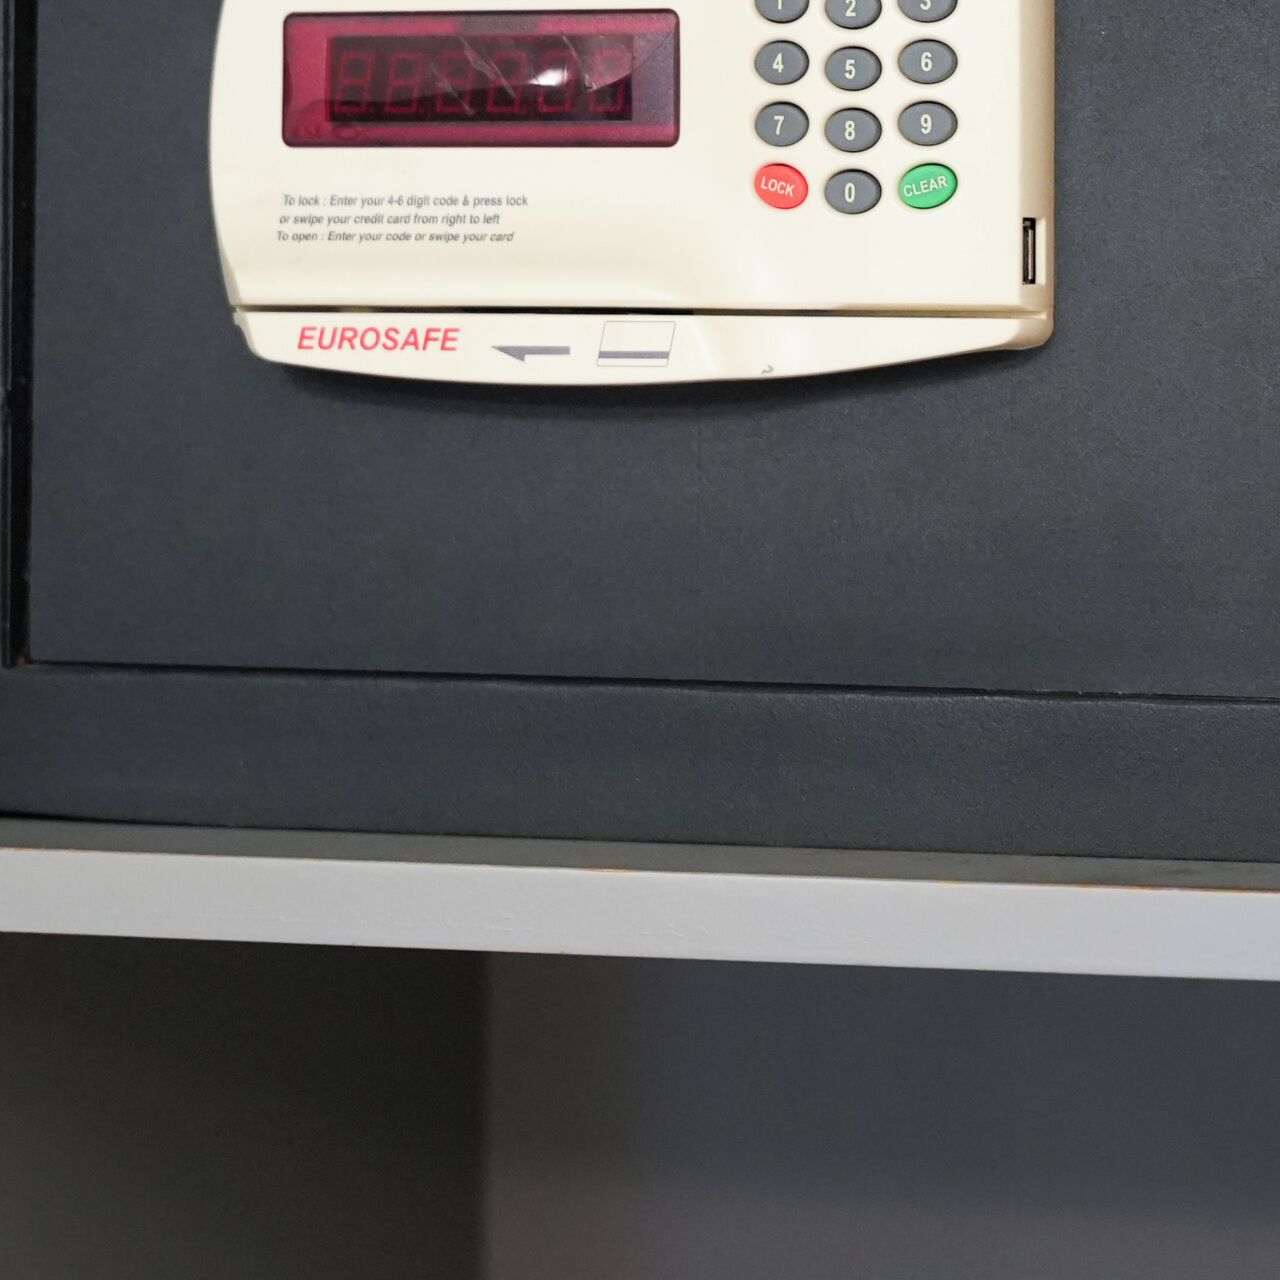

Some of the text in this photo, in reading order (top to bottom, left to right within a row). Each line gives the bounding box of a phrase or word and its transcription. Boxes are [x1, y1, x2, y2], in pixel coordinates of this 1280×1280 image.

[772, 52, 932, 80] 4 5 6
[773, 113, 932, 141] 7 8 9
[283, 194, 295, 206] To
[298, 194, 320, 206] lock
[329, 194, 358, 206] Enter
[360, 197, 385, 209] your
[406, 194, 430, 209] digit
[433, 195, 459, 206] code
[462, 195, 469, 206] &
[472, 197, 503, 209] press
[506, 194, 529, 206] lock
[760, 175, 949, 203] LOCK 0 CLEAR
[279, 213, 501, 227] or swipe your credit card from right to left
[276, 231, 290, 241] To
[291, 233, 318, 244] open
[327, 231, 356, 241] Enter
[358, 233, 383, 244] your
[385, 231, 412, 242] code
[414, 233, 427, 242] or
[429, 231, 460, 244] swipe
[462, 233, 487, 244] your
[489, 232, 515, 242] card
[297, 326, 461, 352] EUROSAFE
